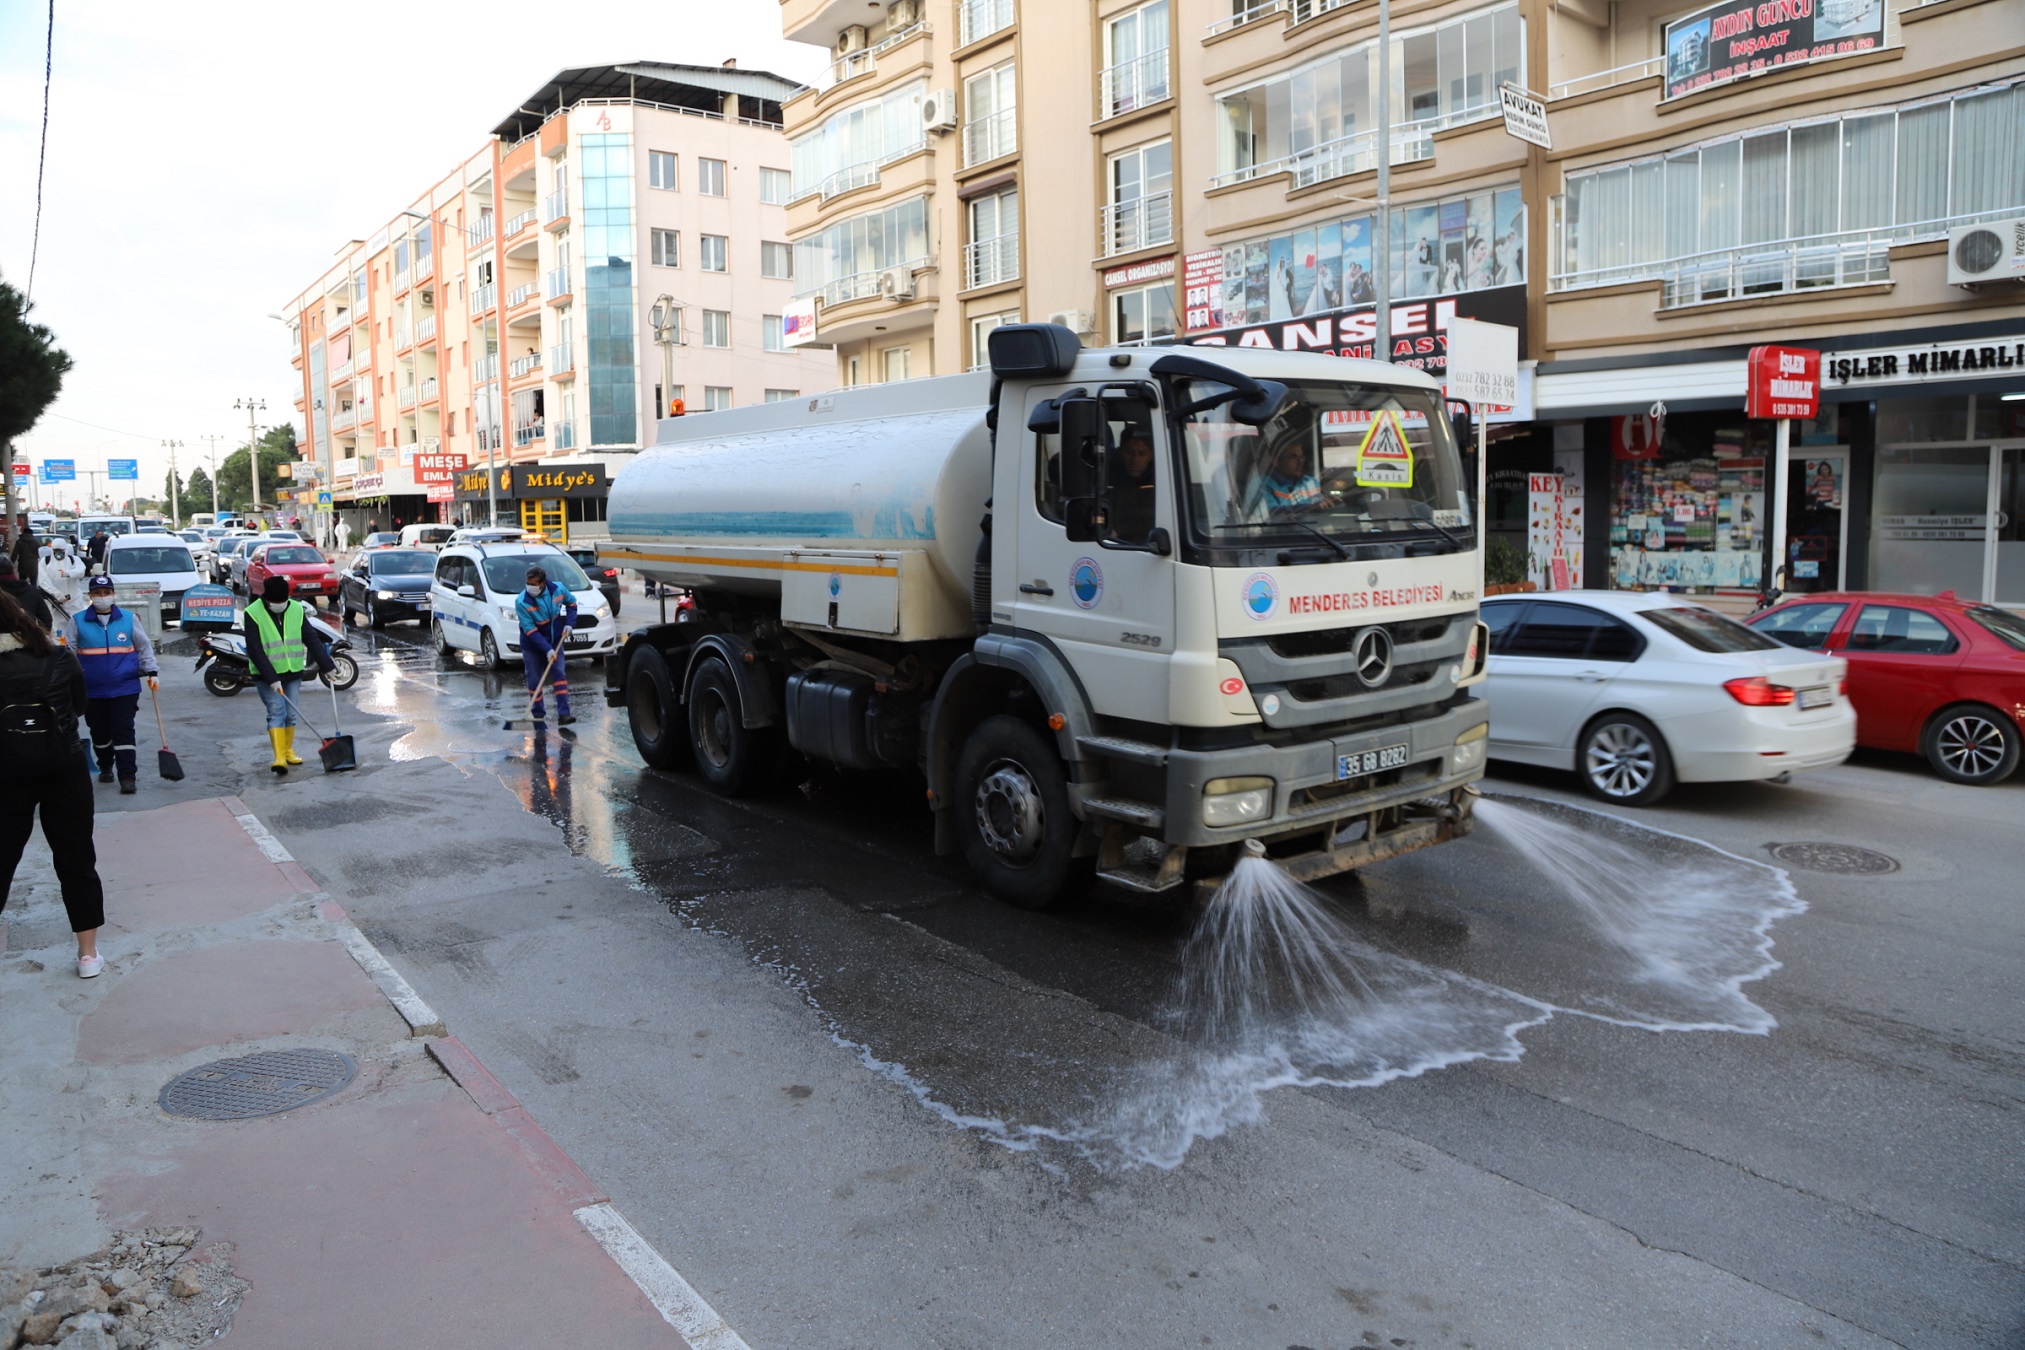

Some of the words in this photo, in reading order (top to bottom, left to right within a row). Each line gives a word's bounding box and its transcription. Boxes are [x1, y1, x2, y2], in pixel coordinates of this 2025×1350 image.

[1711, 7, 1754, 42] AYDIN
[1730, 30, 1789, 58] İNŞAAT
[1785, 49, 1808, 62] 532
[1810, 44, 1834, 57] 415
[1837, 41, 1854, 53] 06
[1857, 38, 1874, 50] 69
[1504, 92, 1542, 119] AVUKAT
[1105, 270, 1127, 286] CANSEL
[1779, 350, 1806, 378] İŞLER
[1829, 351, 1898, 384] İŞLER
[1474, 371, 1490, 385] 782
[1492, 373, 1502, 386] 32
[1504, 376, 1515, 388] 88
[1770, 375, 1814, 399] MİMARLIK
[1474, 385, 1490, 398] 587
[1772, 403, 1777, 415] 0
[420, 456, 463, 470] MEŞE
[526, 471, 595, 492] Midye's
[1368, 471, 1402, 480] Kasis
[1531, 476, 1564, 493] KEY
[188, 598, 211, 607] HEDİYE
[213, 597, 231, 606] PİZZA
[1289, 593, 1368, 614] MENDERES
[1372, 581, 1443, 608] BELEDİYESİ
[200, 609, 231, 618] YE-KAZAN
[1120, 632, 1161, 647] 2529
[1346, 756, 1360, 775] 35
